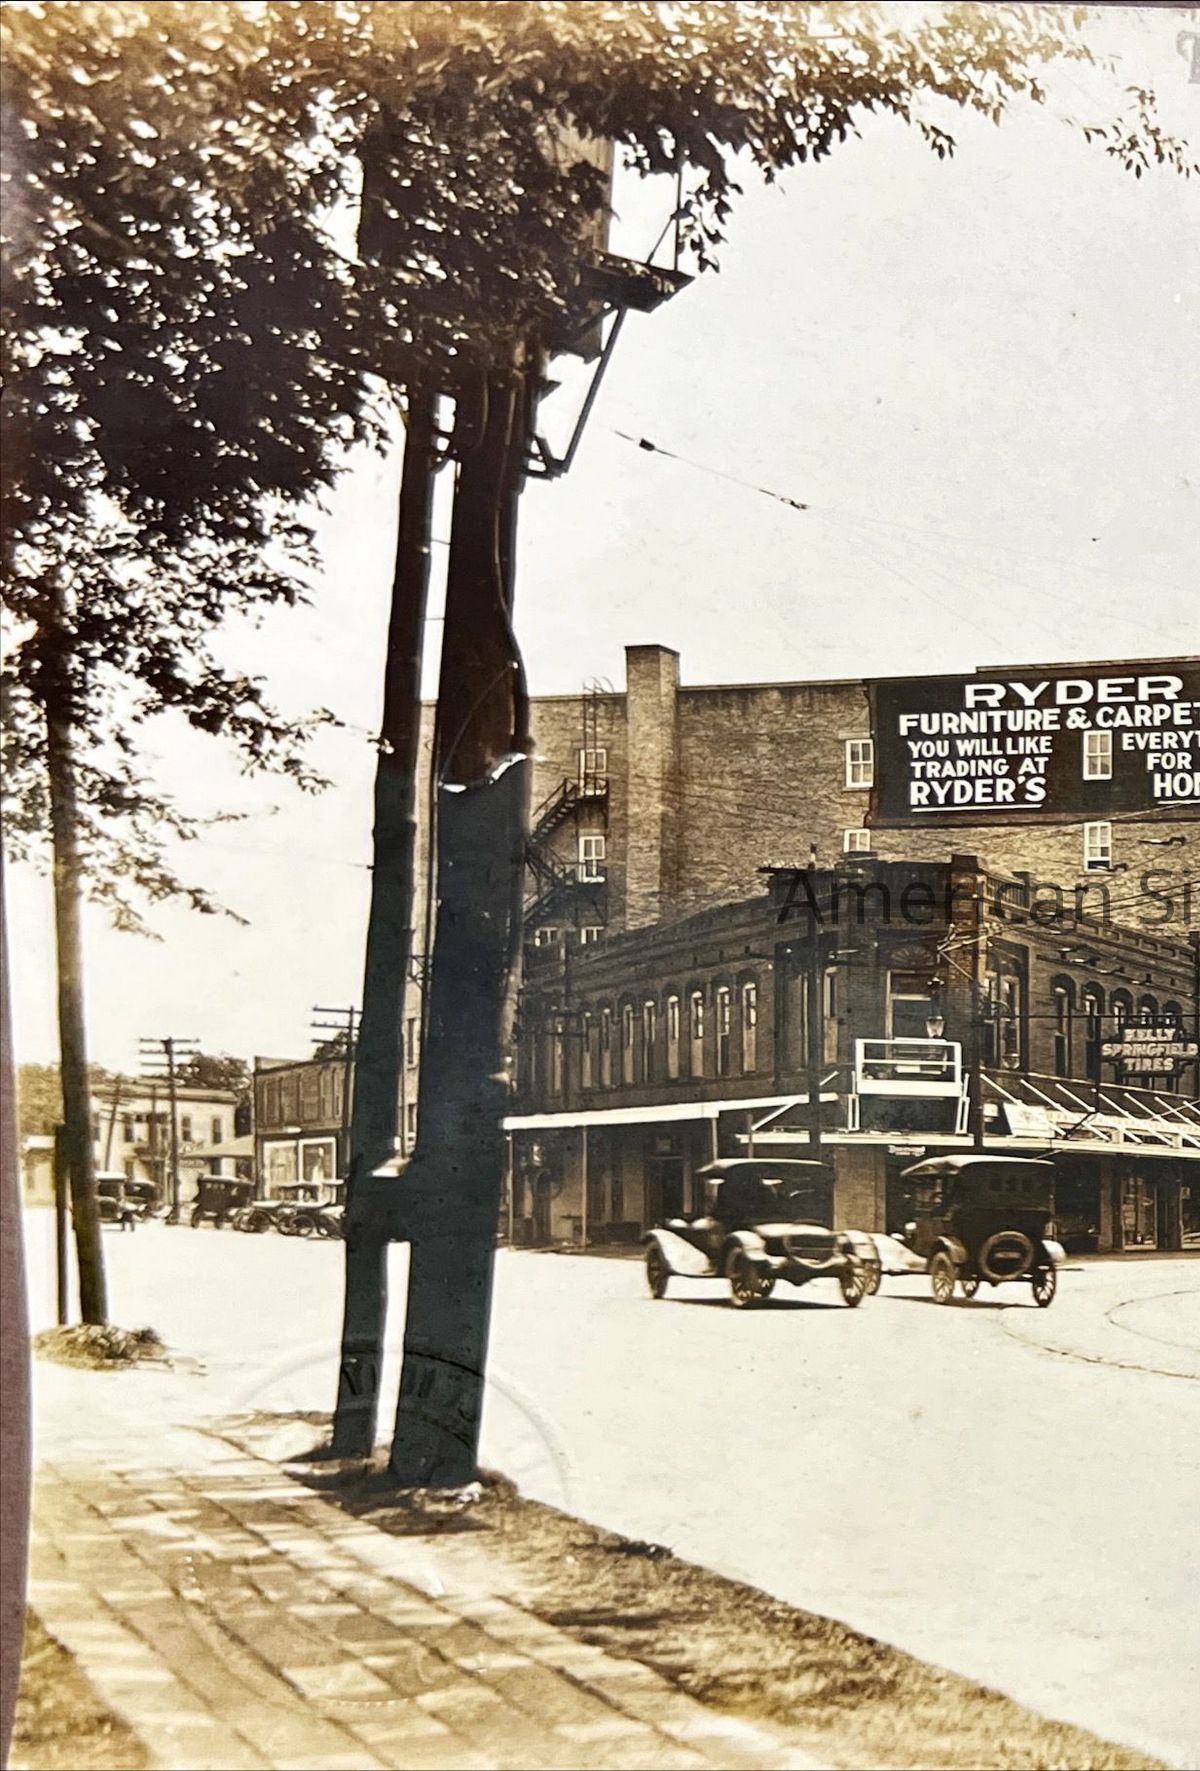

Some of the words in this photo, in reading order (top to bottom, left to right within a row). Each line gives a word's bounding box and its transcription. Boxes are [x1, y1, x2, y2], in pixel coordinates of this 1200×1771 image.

[965, 675, 1184, 709] RYDER
[899, 708, 1061, 736] FURNITURE
[1066, 707, 1092, 730] &
[908, 740, 949, 758] YOU
[956, 738, 1003, 756] WILL
[1006, 736, 1053, 755] LIKE
[910, 758, 1010, 778] TRADING
[1018, 757, 1049, 775] AT
[1146, 752, 1193, 771] FOR
[910, 776, 1047, 805] RYDER'S
[1123, 1028, 1177, 1041] KELLY
[1101, 1043, 1199, 1057] SPRINGFIELD
[1123, 1058, 1174, 1072] TIRES
